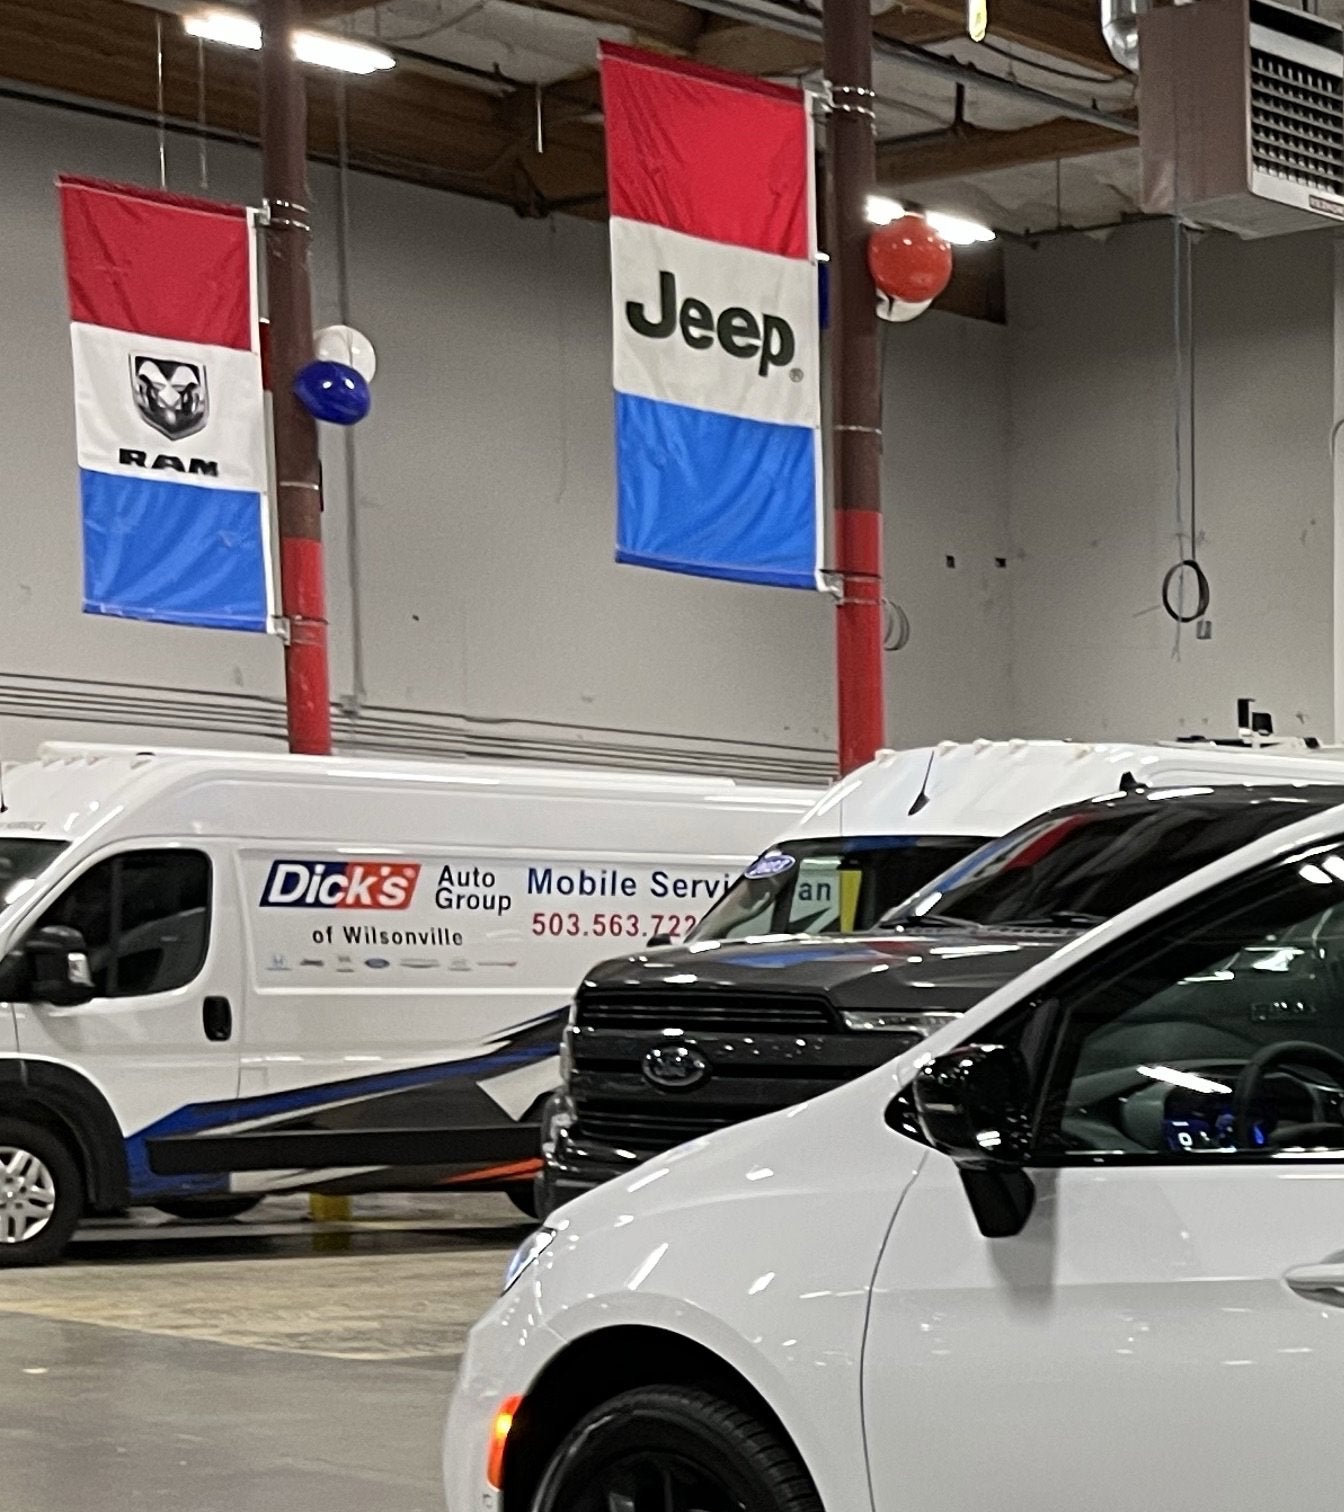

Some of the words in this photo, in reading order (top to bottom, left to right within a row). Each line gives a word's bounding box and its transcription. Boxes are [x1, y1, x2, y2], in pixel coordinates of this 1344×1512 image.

[625, 270, 796, 378] Jeep
[118, 448, 218, 478] RAM
[438, 865, 496, 888] Auto
[527, 868, 637, 896] Mobile
[651, 871, 730, 898] Servi
[799, 881, 832, 901] an
[435, 887, 512, 917] Group
[312, 926, 333, 944] of
[343, 926, 463, 946] Wilsonville
[532, 912, 699, 937] 503.563.722
